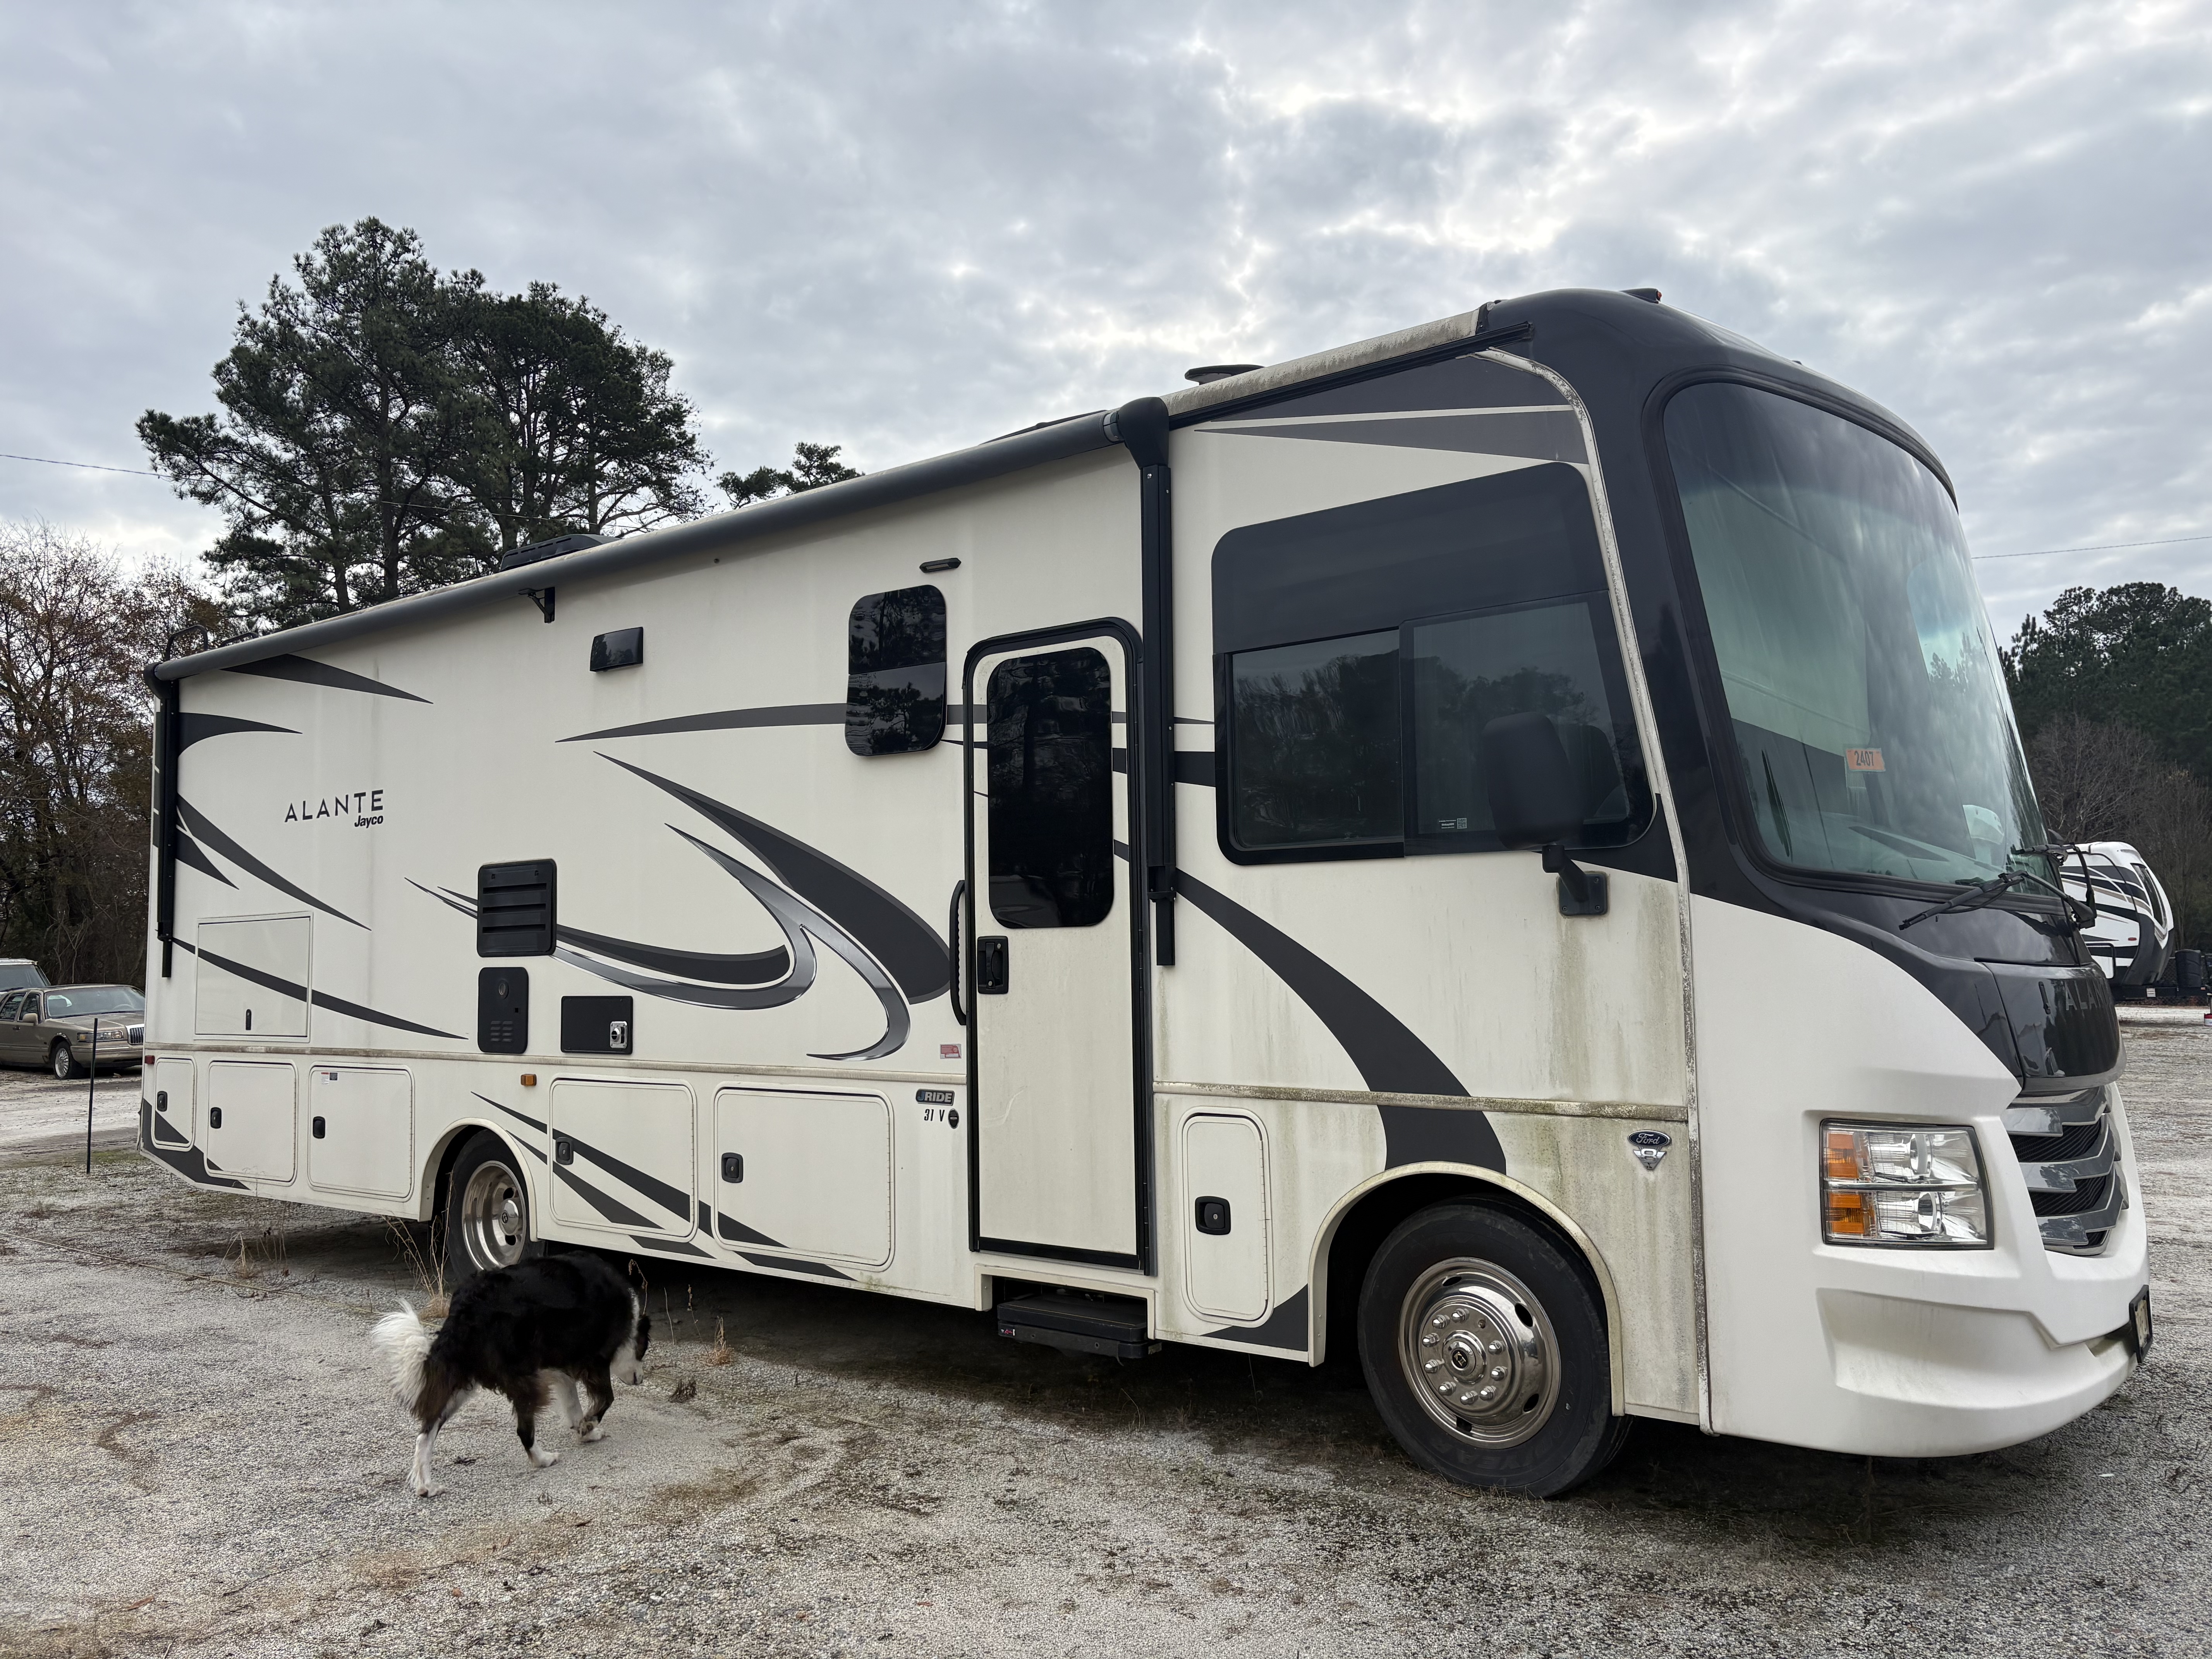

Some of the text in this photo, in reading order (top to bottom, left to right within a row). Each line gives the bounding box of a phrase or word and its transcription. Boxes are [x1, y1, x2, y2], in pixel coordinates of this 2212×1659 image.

[1855, 750, 1874, 766] 2407
[284, 789, 383, 823] ALANTE
[354, 815, 383, 828] Jayco
[917, 1091, 952, 1103] JRIDE
[924, 1109, 934, 1121] 31
[939, 1109, 945, 1121] V
[1636, 1133, 1660, 1144] Ford
